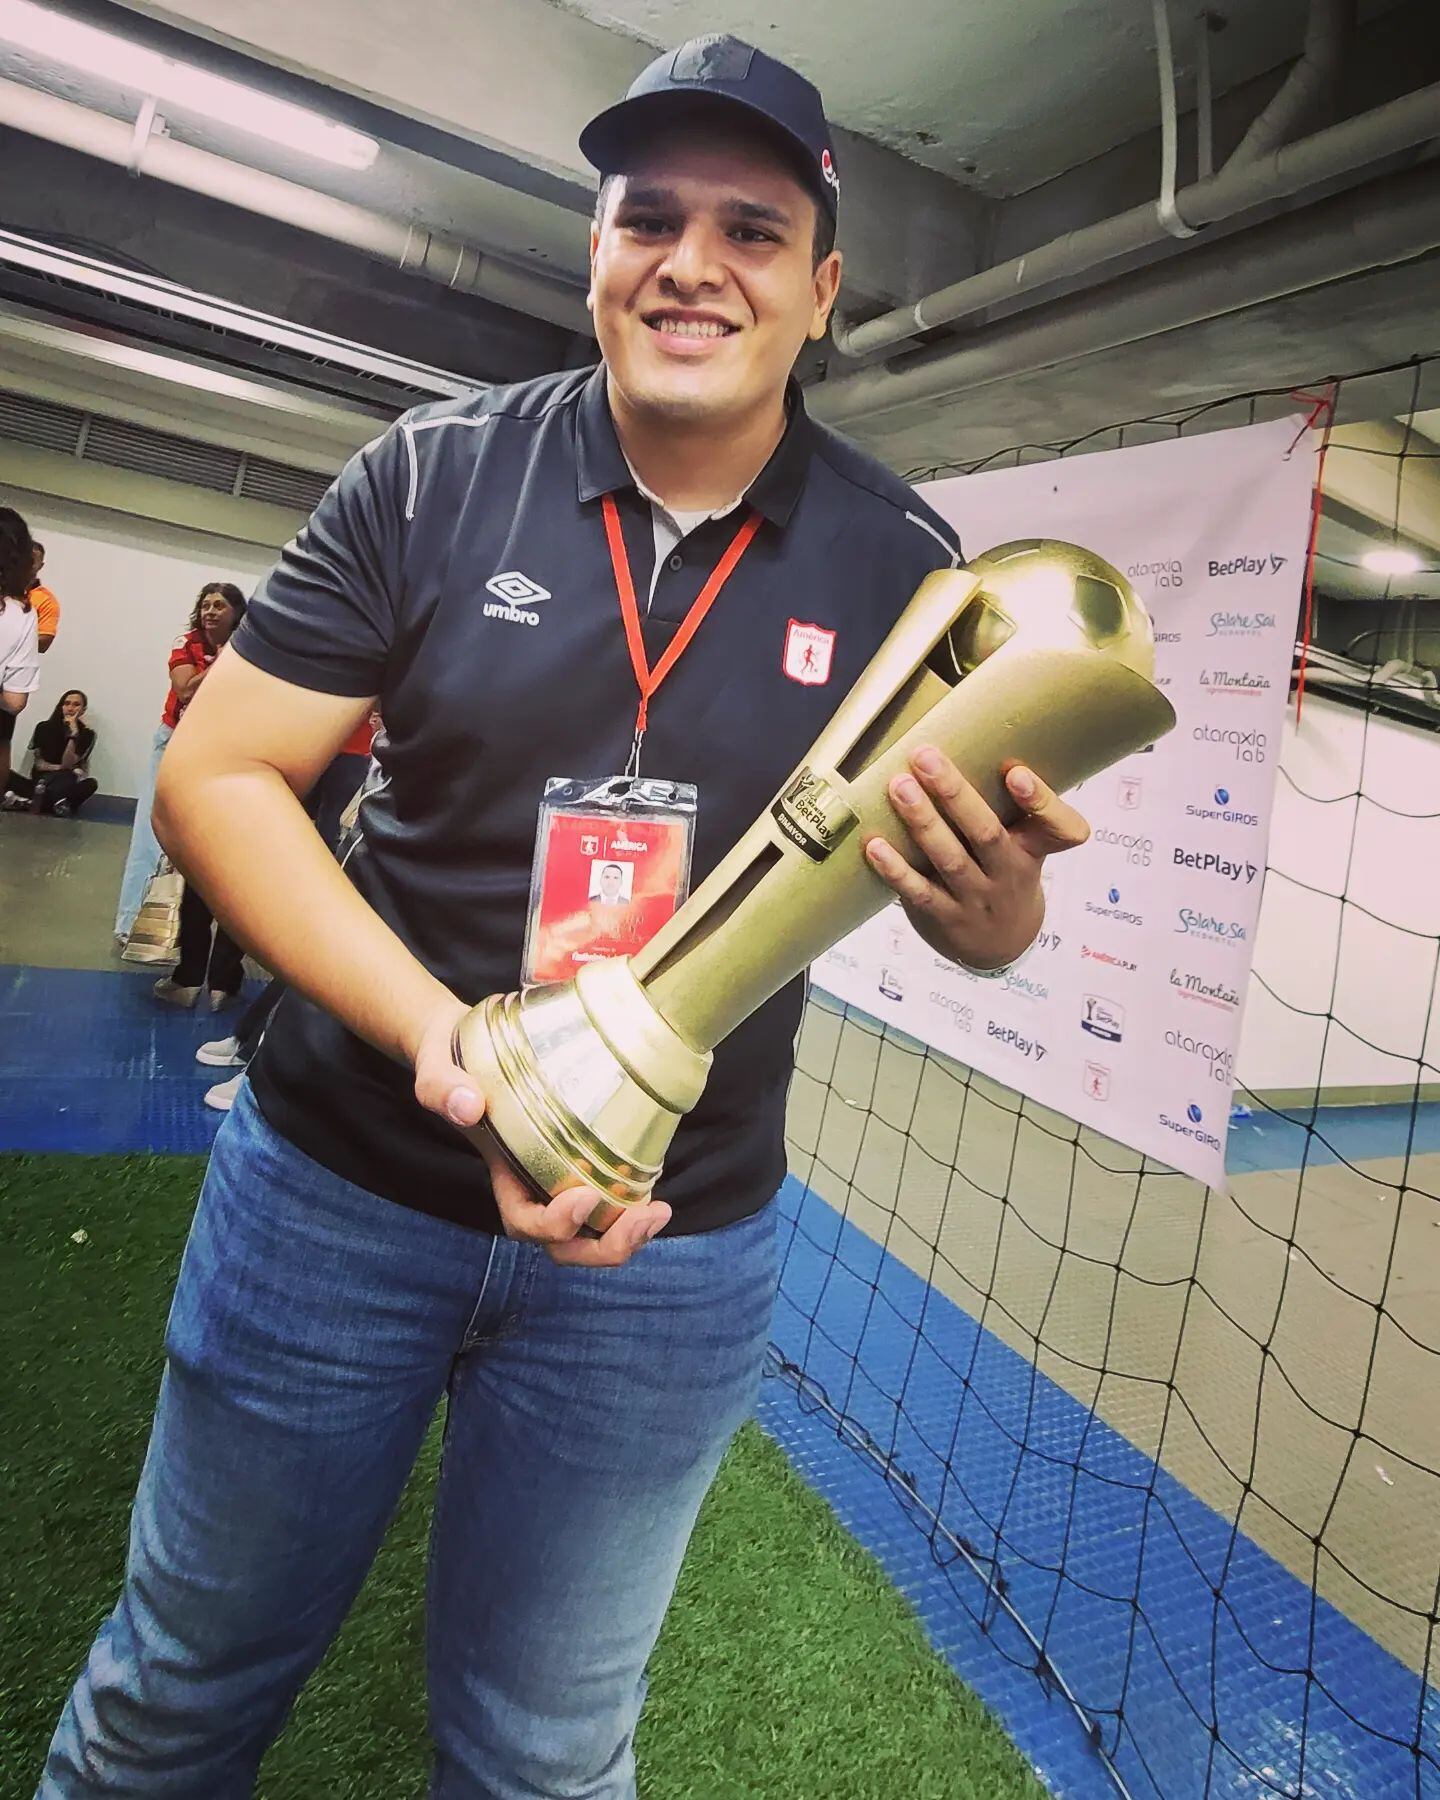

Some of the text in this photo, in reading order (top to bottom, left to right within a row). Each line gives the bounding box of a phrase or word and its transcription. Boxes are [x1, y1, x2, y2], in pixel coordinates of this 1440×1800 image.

[1128, 558, 1182, 578] ataraxia
[1208, 556, 1266, 576] BetPlay
[1154, 574, 1183, 587] lab
[483, 602, 540, 627] umbro
[1212, 671, 1271, 689] Montaña
[1193, 723, 1267, 748] ataraxia
[1235, 745, 1265, 763] lab
[795, 799, 834, 840] BetPlay
[1186, 805, 1259, 826] SuperGIROS
[777, 812, 807, 846] DIMAYOR
[1094, 827, 1154, 853] ataraxia
[1126, 850, 1152, 867] lab
[1173, 847, 1242, 881] BetPlay
[1085, 902, 1143, 926] SuperGIROS
[1227, 923, 1247, 941] Sa
[987, 1020, 1033, 1056] BetPlay
[1159, 1114, 1221, 1152] SuperGIRO
